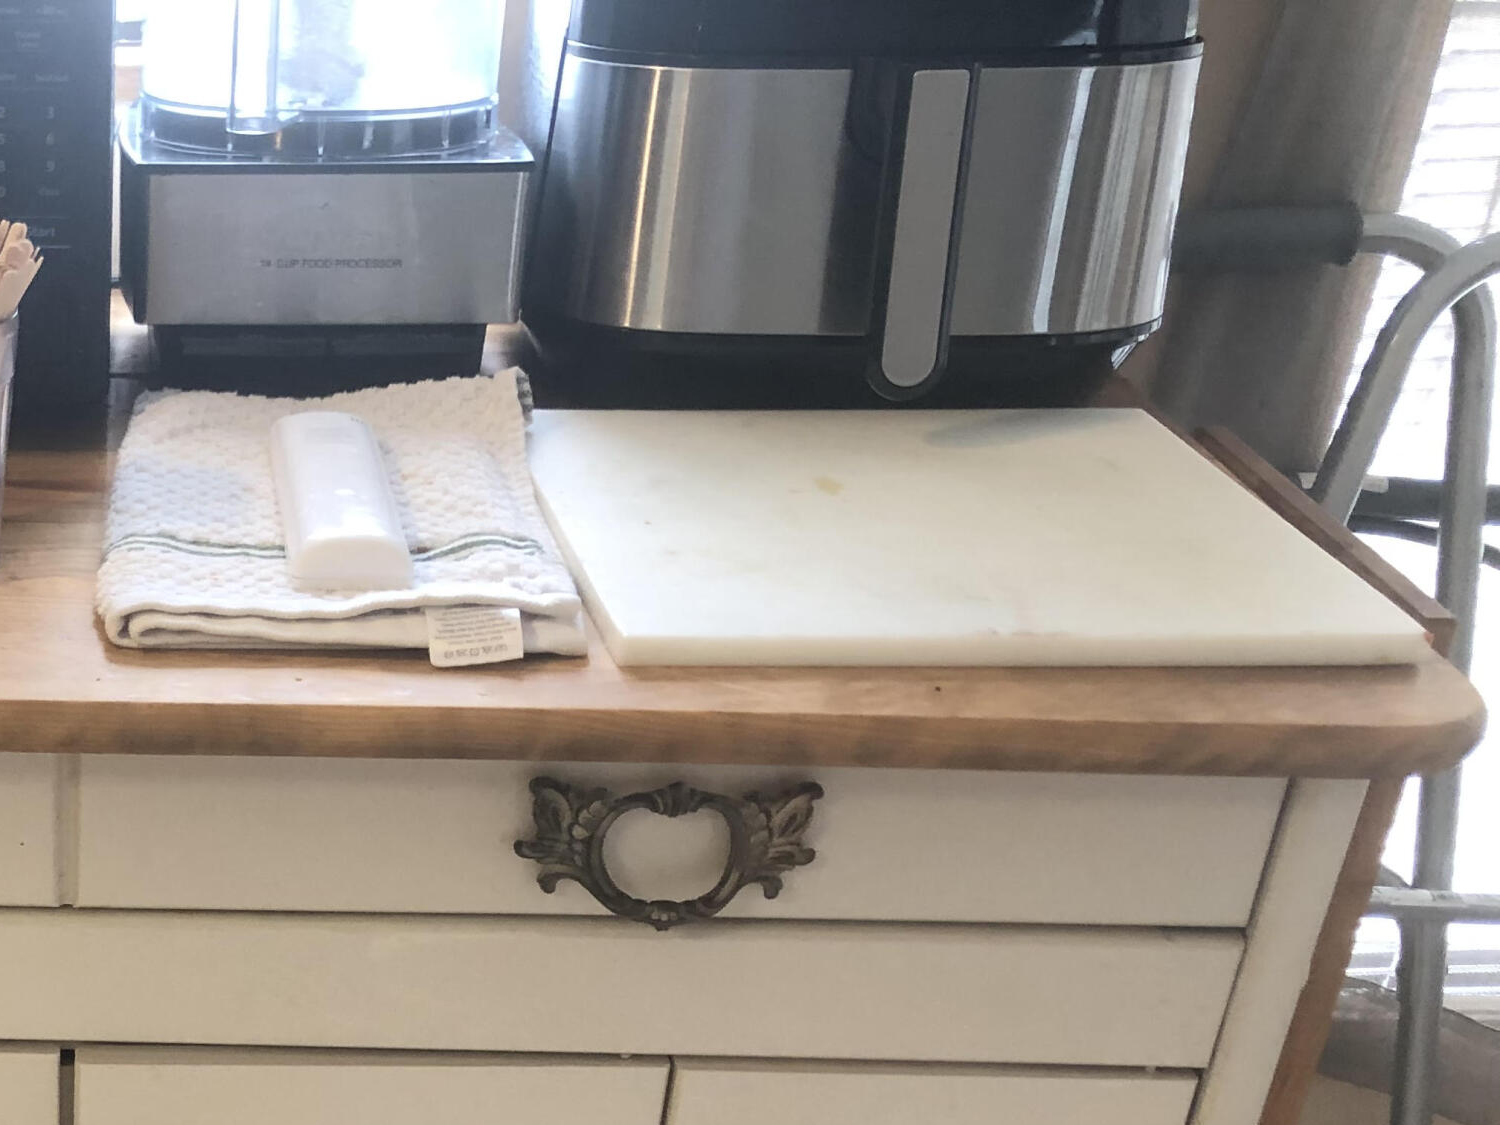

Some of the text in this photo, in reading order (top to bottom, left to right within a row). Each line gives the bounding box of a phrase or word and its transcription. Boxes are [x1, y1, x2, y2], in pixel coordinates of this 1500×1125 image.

[46, 106, 55, 119] 3
[45, 132, 55, 146] 6
[45, 160, 55, 172] 9
[276, 258, 300, 269] CUP
[302, 258, 332, 269] FOOD
[335, 258, 403, 269] PROCESSOR
